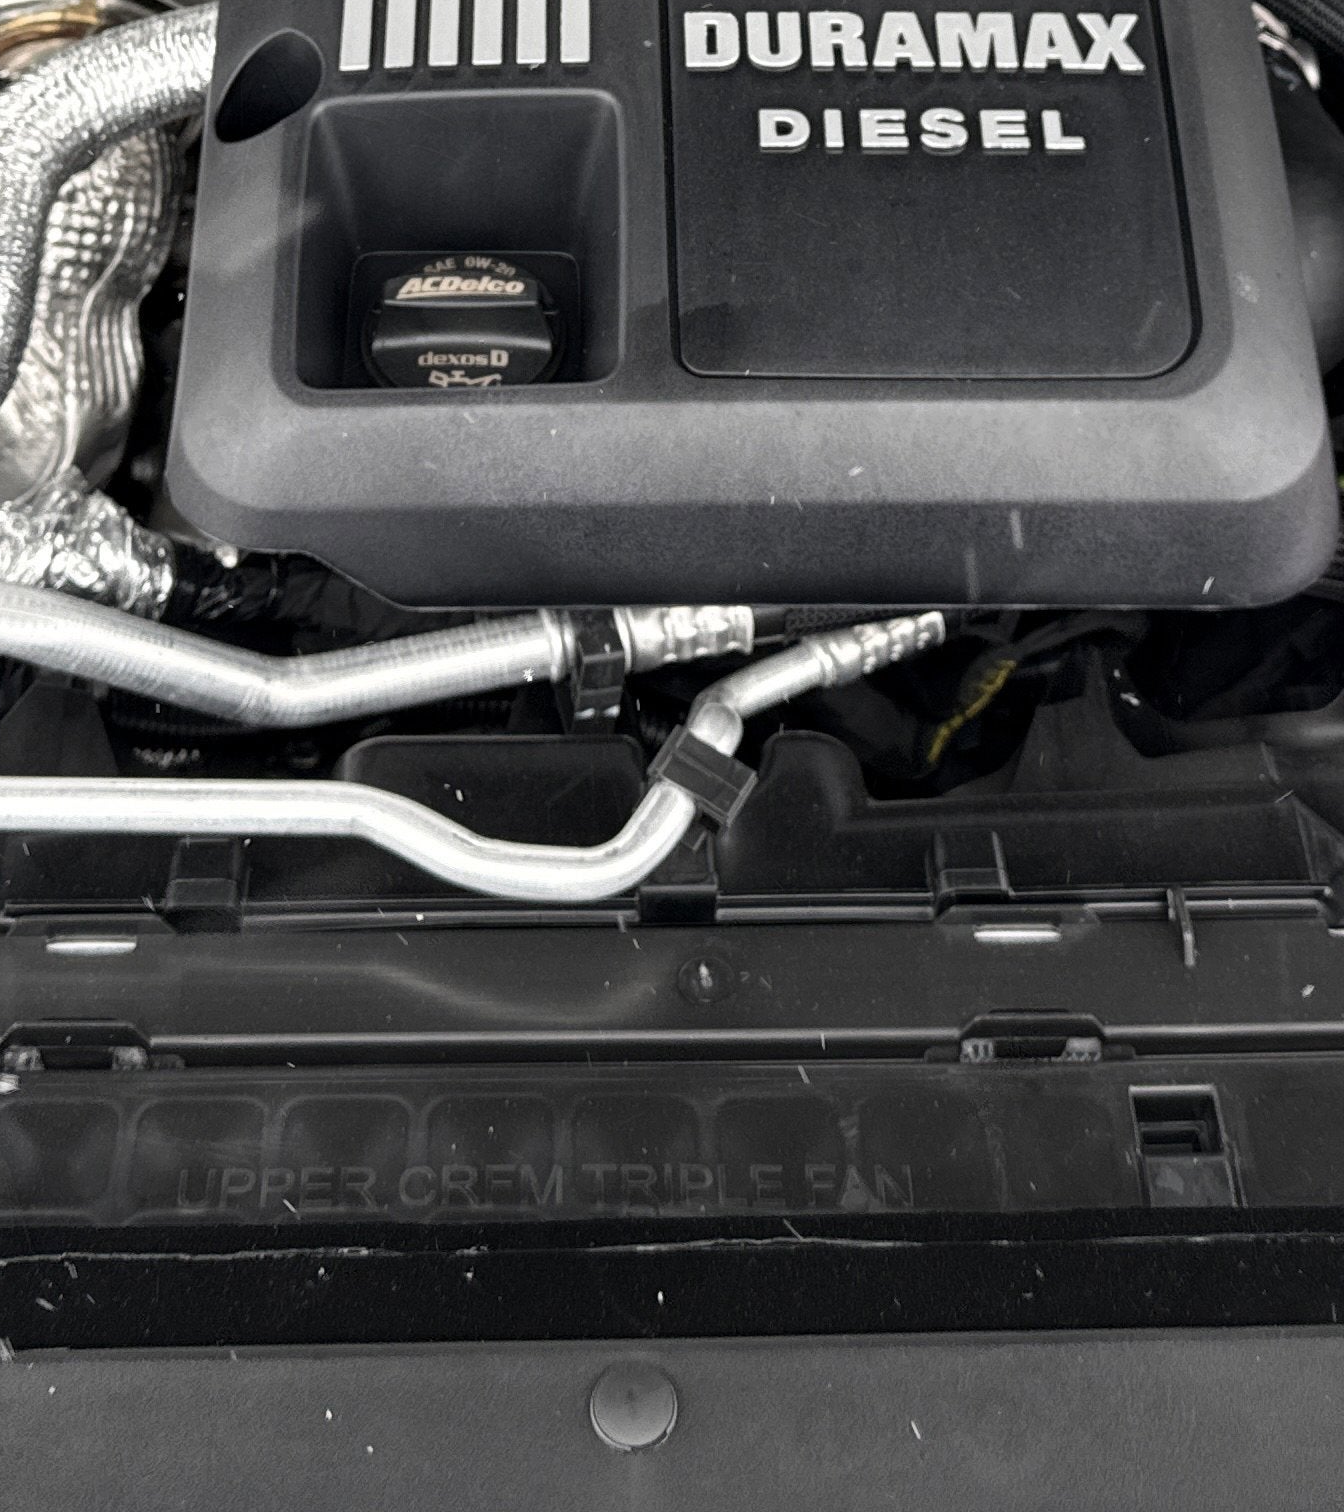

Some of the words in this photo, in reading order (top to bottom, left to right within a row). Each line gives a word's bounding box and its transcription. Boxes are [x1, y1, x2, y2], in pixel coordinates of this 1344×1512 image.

[683, 10, 1146, 75] DURAMAX
[758, 108, 1086, 154] DIESEL
[397, 275, 525, 298] ACDelco
[423, 257, 457, 273] SAE
[177, 1165, 385, 1211] UPPER
[398, 1163, 566, 1210] CRFM
[580, 1162, 787, 1207] TRIPLE
[804, 1163, 914, 1208] FAN
